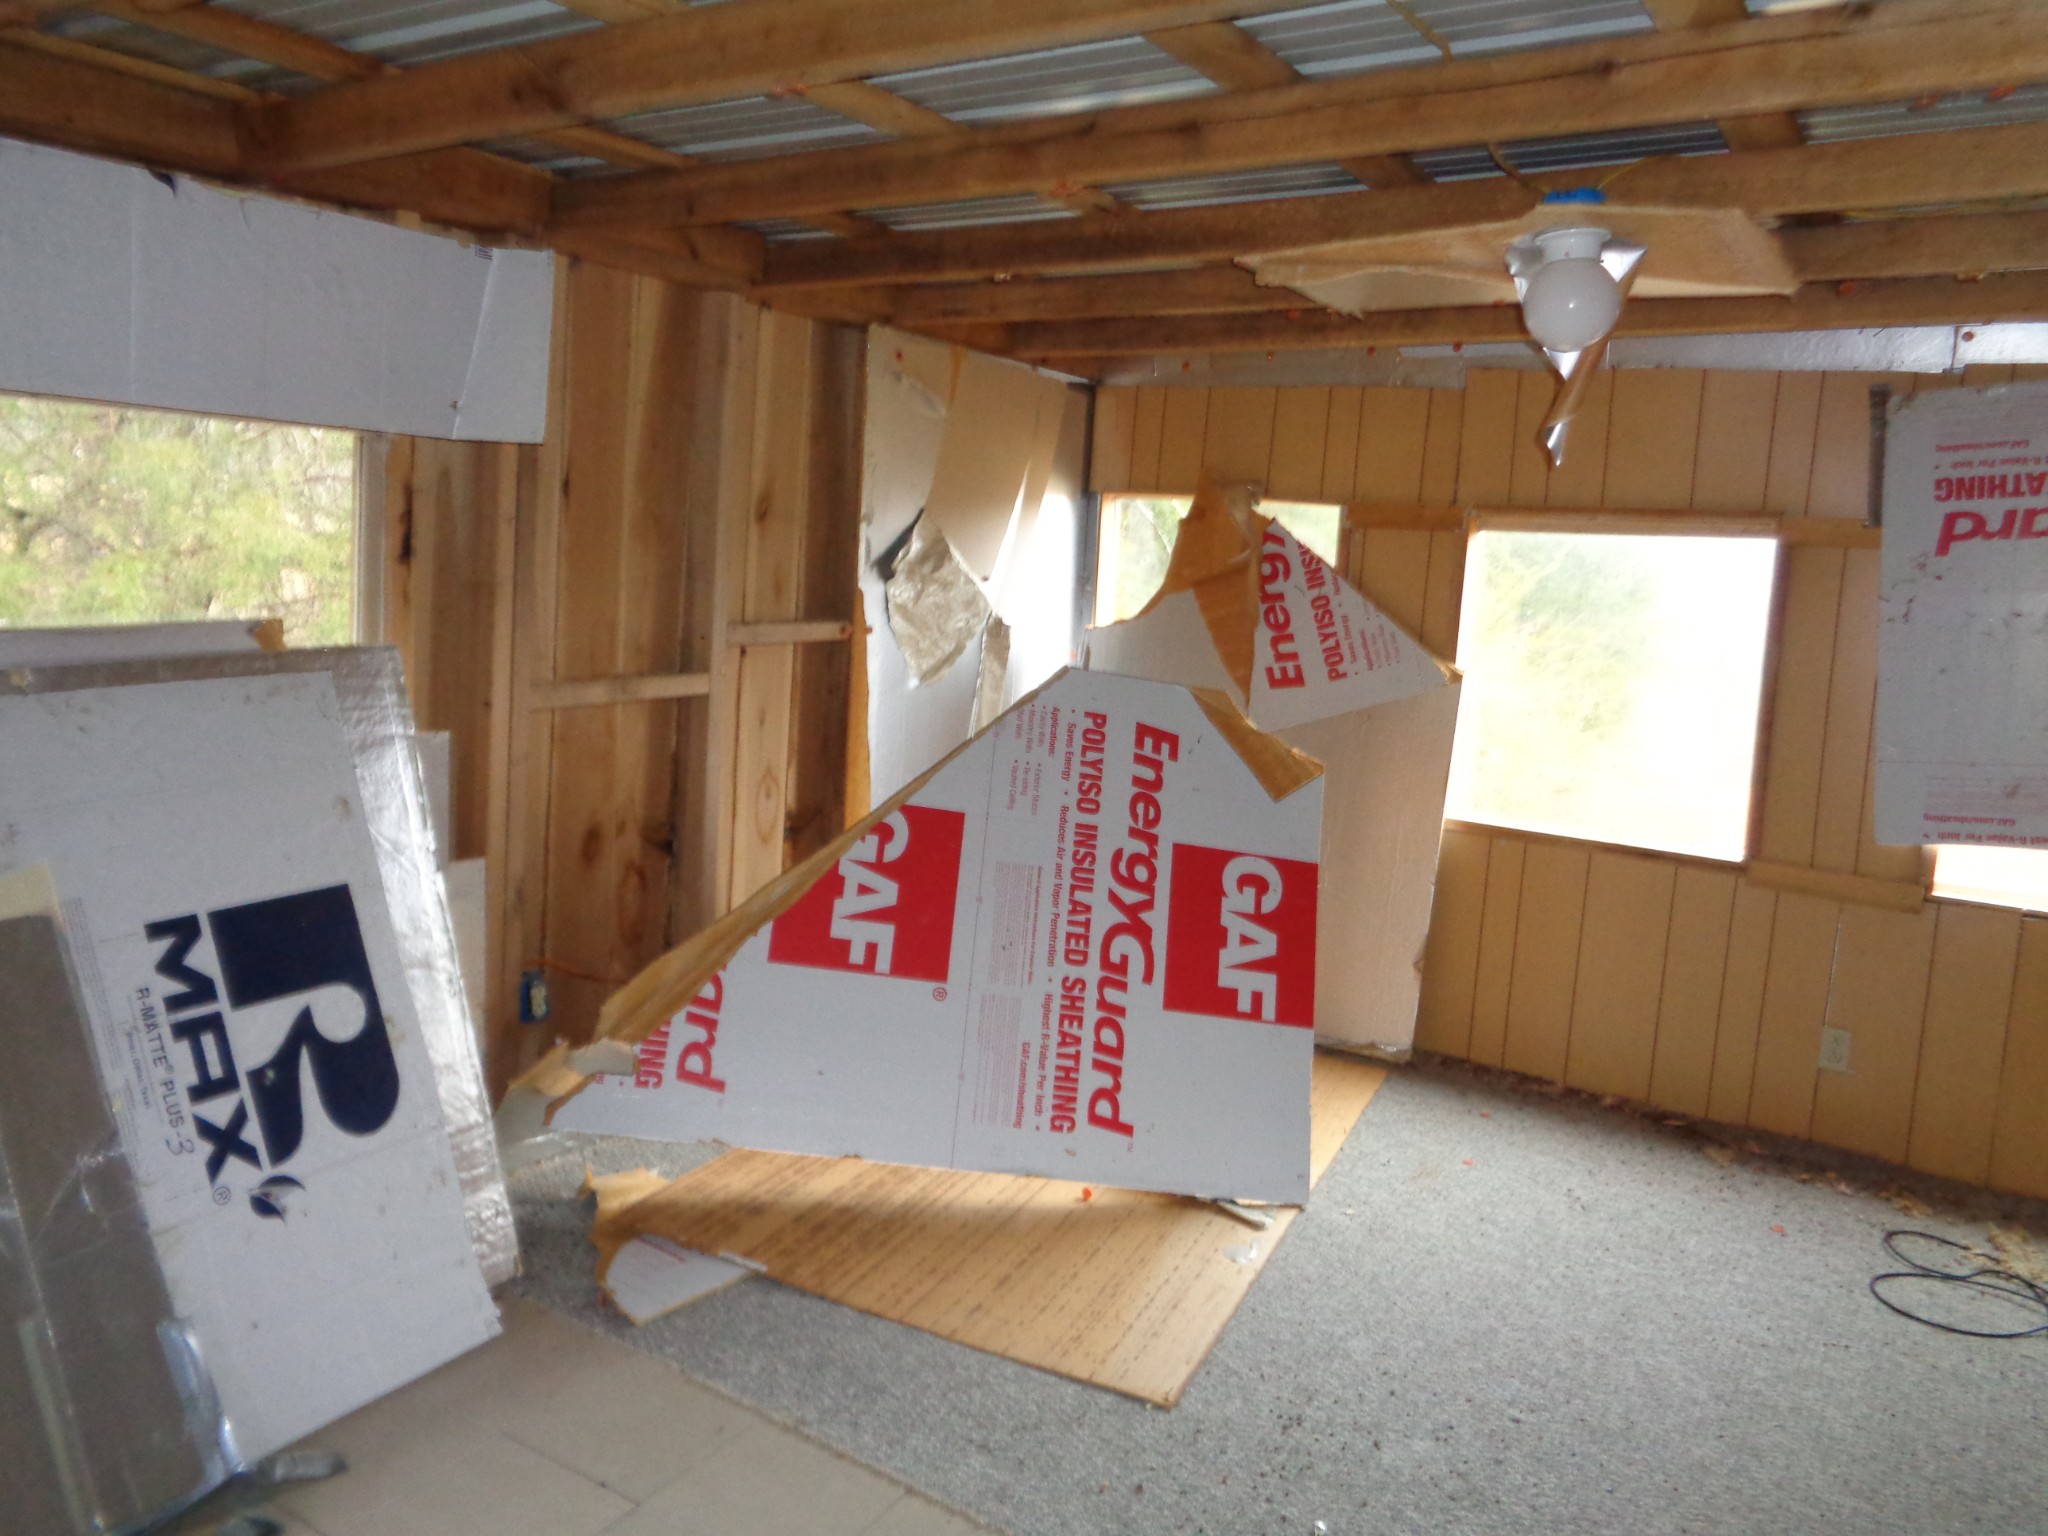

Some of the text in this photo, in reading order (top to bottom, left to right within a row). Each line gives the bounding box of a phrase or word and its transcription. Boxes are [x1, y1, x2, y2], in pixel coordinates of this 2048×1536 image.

[1310, 595, 1347, 683] POLYISO
[1048, 707, 1060, 757] Applications:
[830, 810, 909, 975] GAF
[1034, 723, 1076, 1116] Saves Energy Reduces Air and Vapor Penetration Highest R-Value Per Inch
[1050, 711, 1107, 1133] POLYISO INSULATED SHEATHING
[1217, 856, 1283, 1022] GAF
[1013, 1042, 1030, 1129] GAF.com/sheathing
